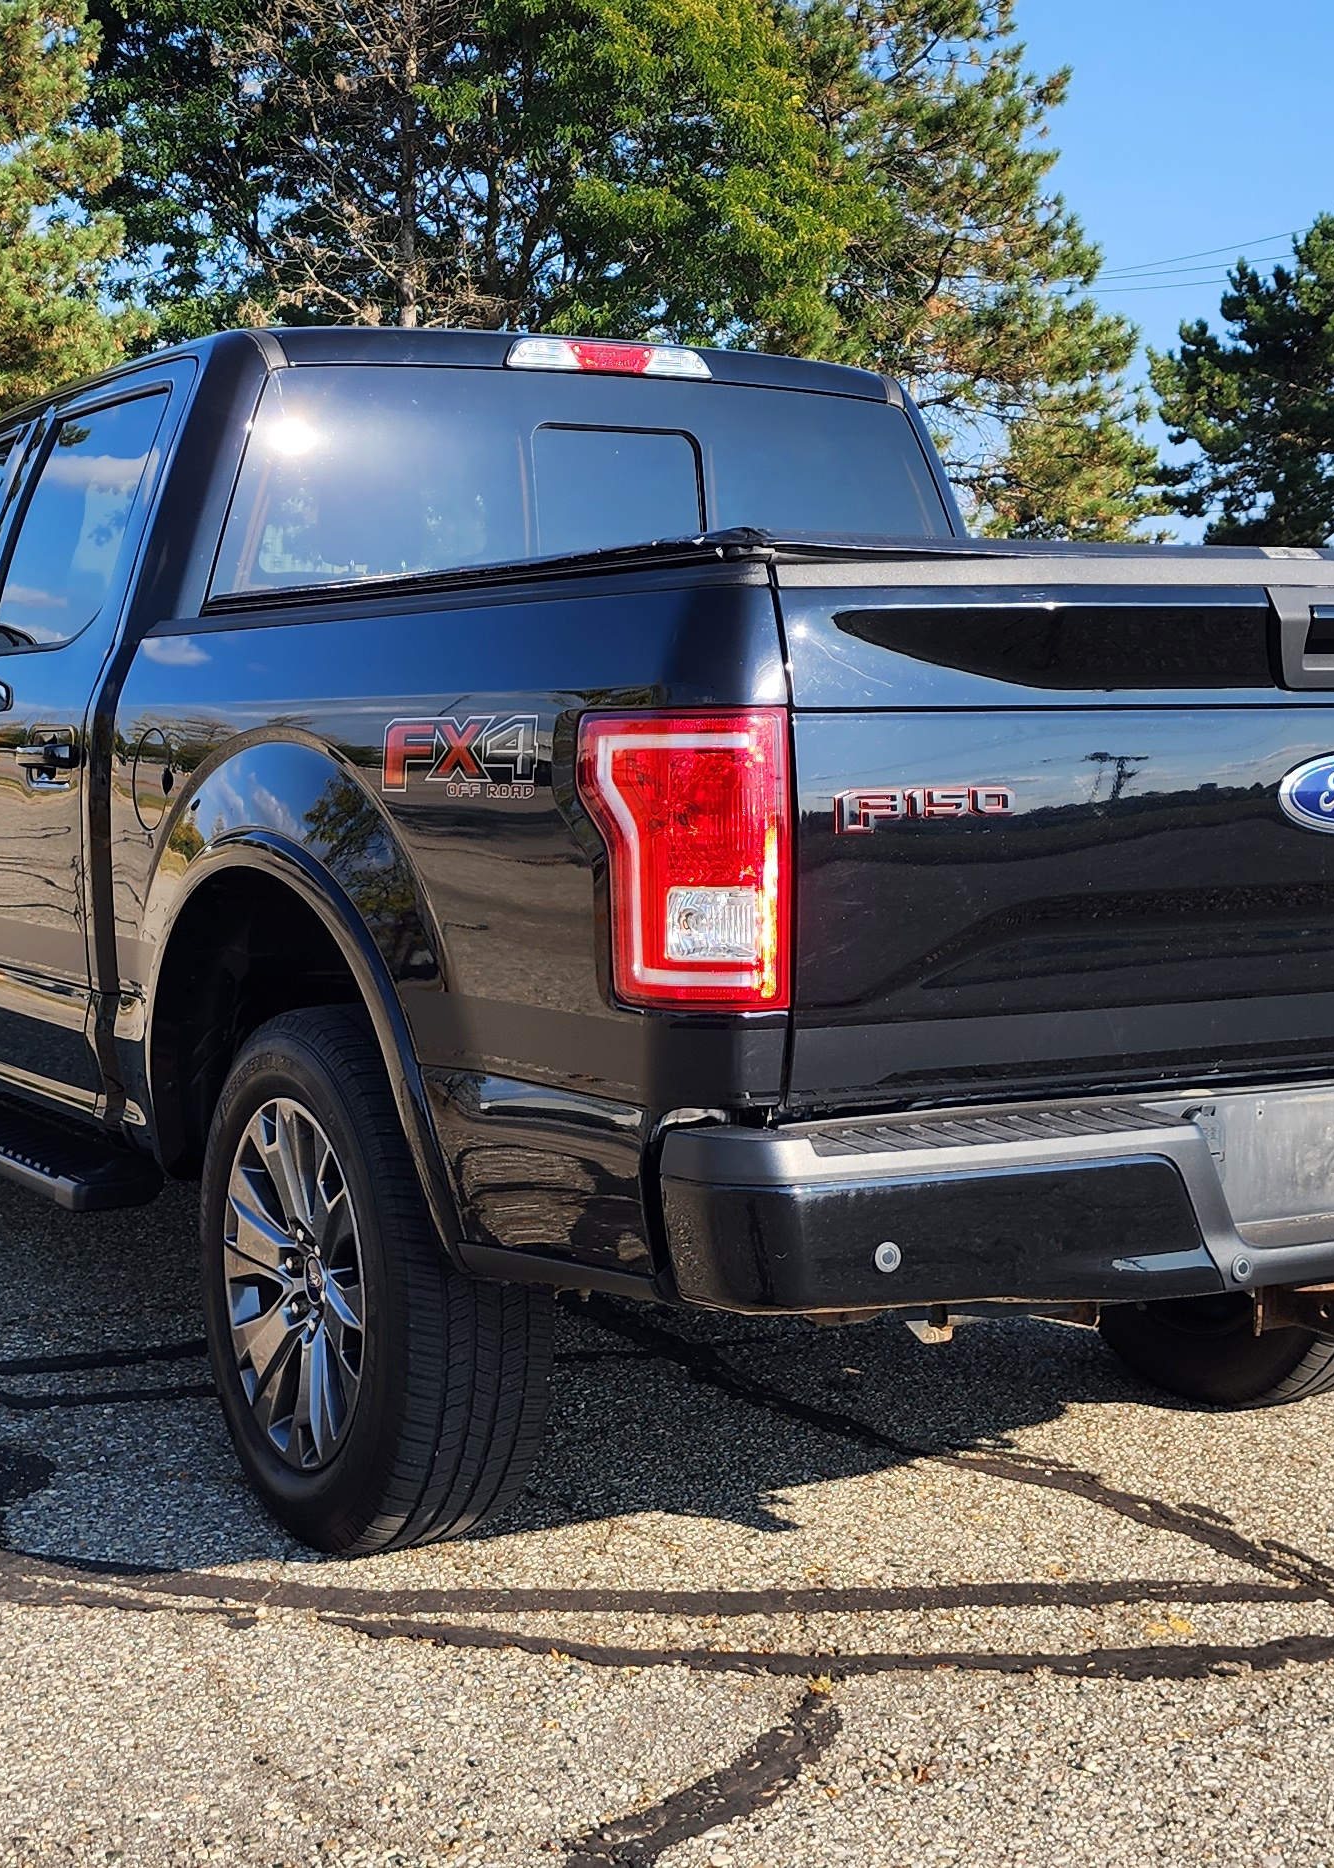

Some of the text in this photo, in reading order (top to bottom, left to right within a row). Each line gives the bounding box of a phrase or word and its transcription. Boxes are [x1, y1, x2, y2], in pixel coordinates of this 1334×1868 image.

[382, 715, 539, 792] FX4
[446, 782, 535, 799] OFF ROAD
[833, 786, 1017, 835] F150
